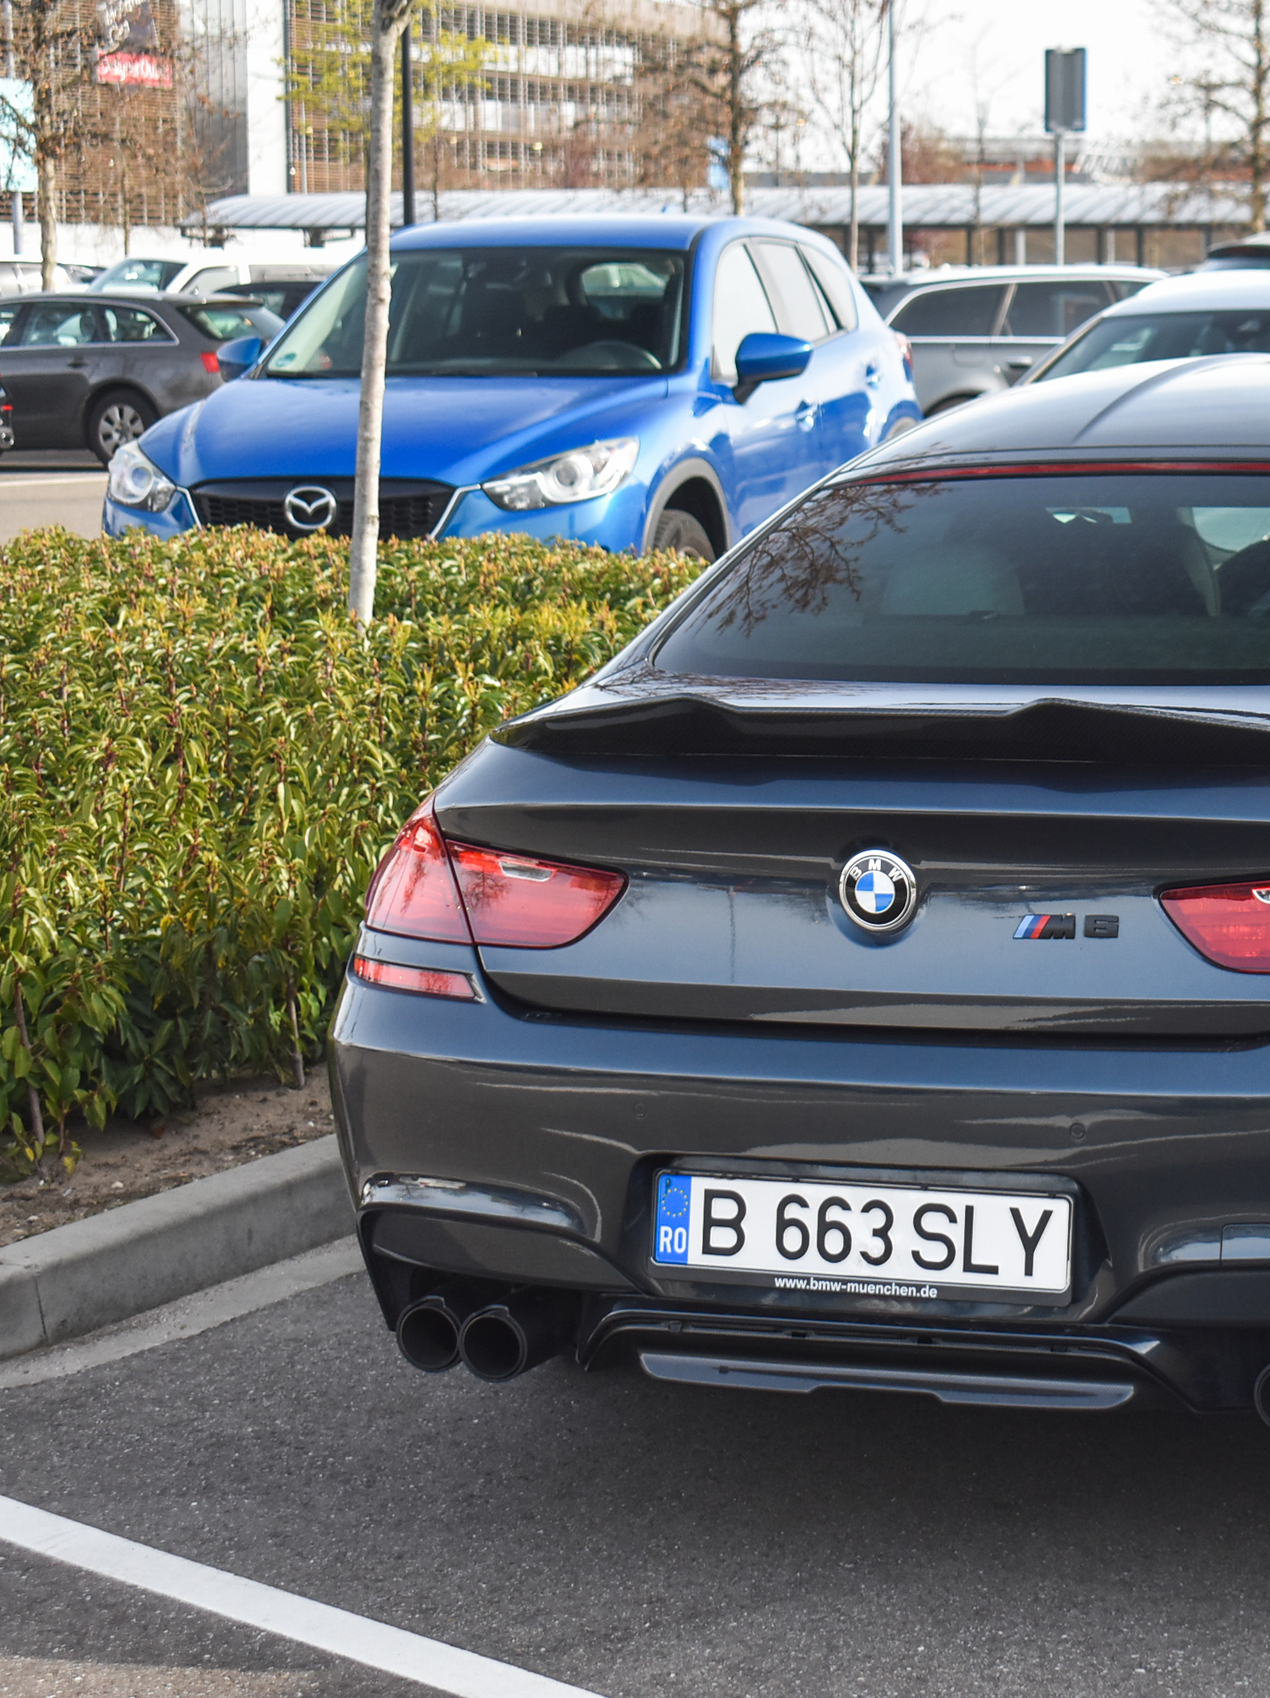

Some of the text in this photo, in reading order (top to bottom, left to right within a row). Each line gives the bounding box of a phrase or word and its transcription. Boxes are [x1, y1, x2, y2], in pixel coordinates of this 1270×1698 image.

[849, 858, 903, 882] BMW
[659, 1225, 687, 1254] RO
[702, 1188, 1054, 1277] B 663 SLY
[774, 1276, 938, 1299] www.bmw-muenchen.de
